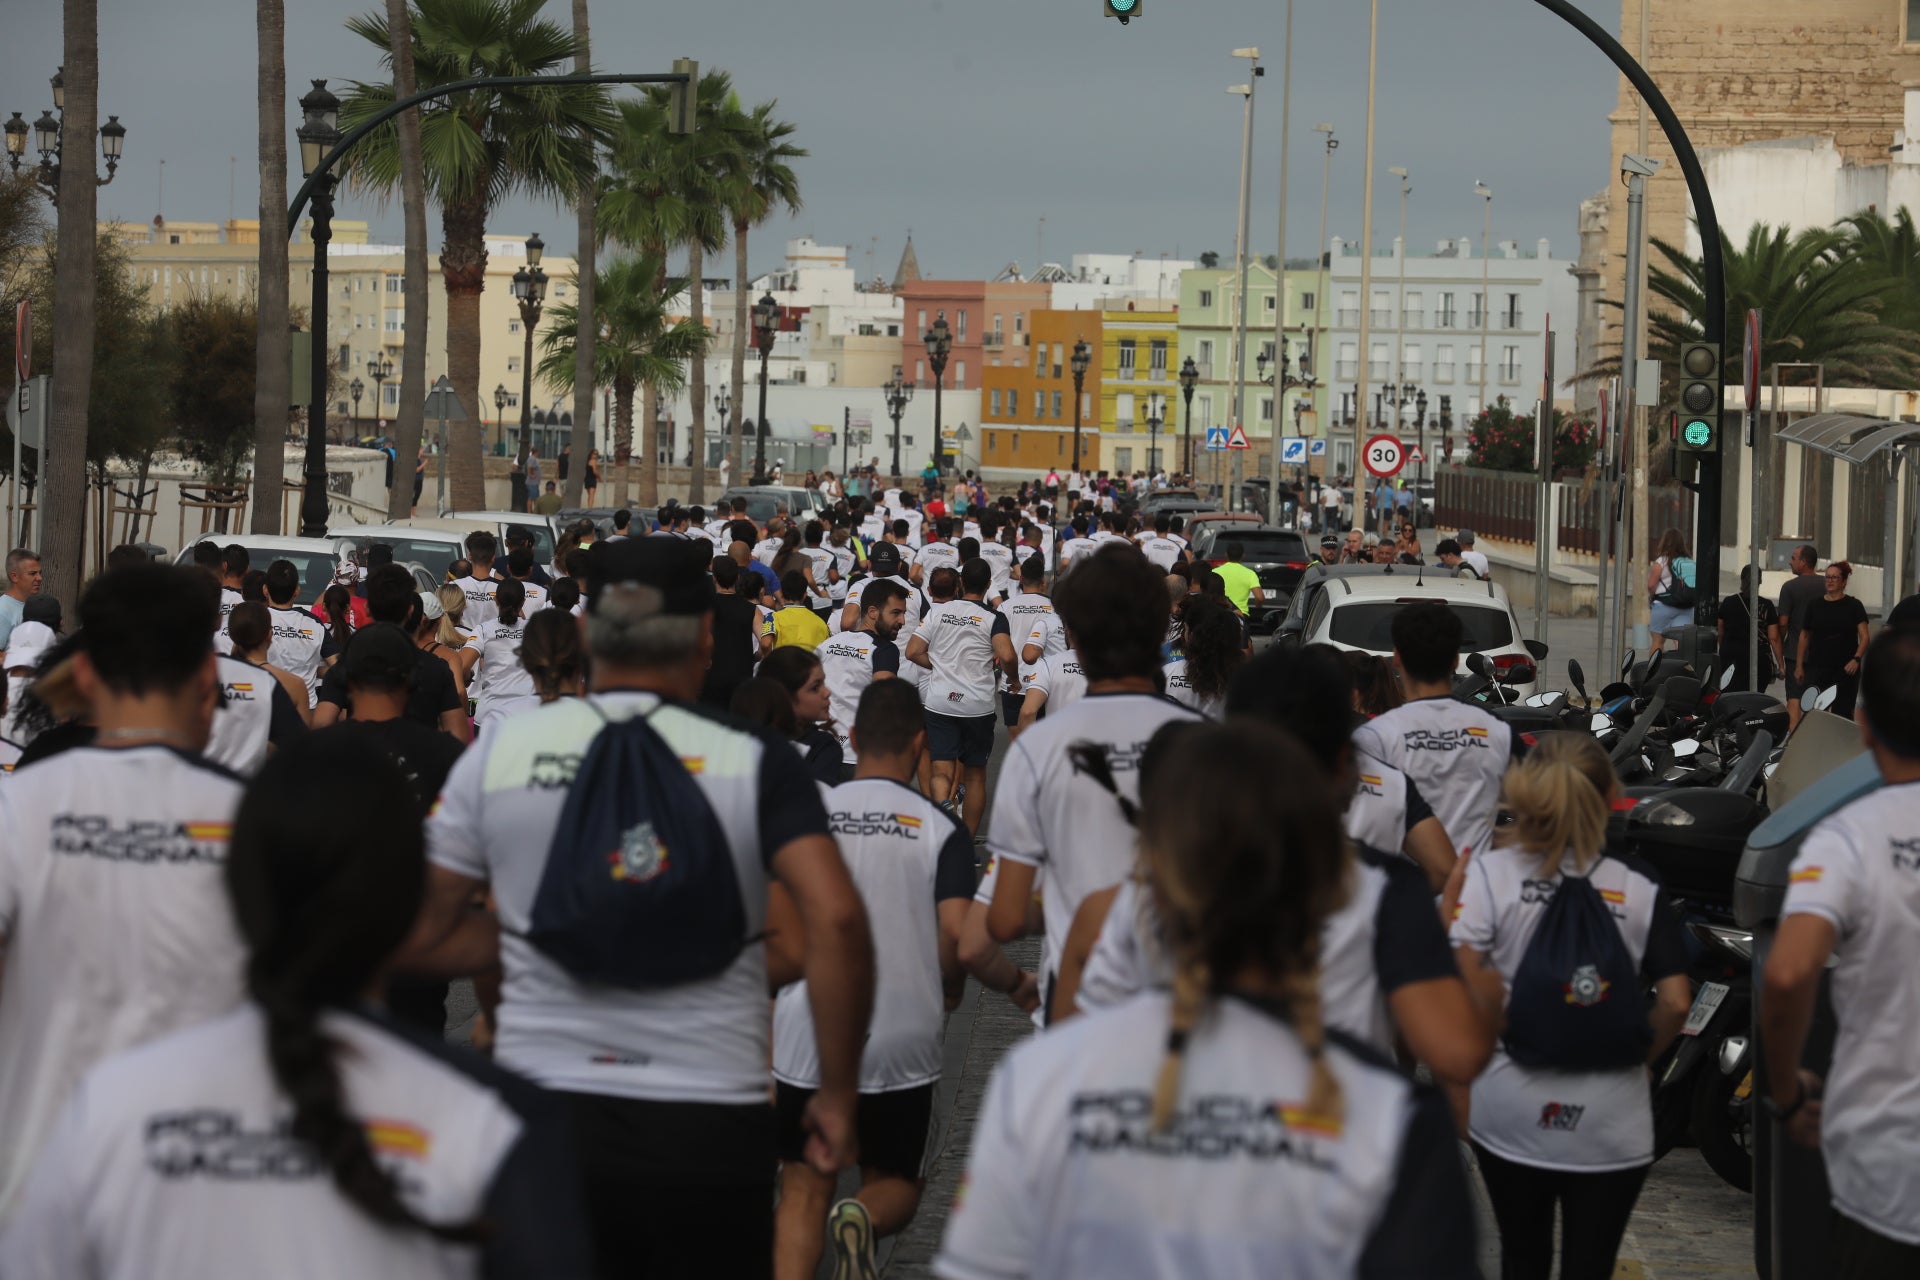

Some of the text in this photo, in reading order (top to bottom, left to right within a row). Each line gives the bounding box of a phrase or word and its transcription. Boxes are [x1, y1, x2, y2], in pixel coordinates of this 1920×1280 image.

[1372, 448, 1396, 463] 30
[271, 631, 314, 640] ACIONAL
[1404, 728, 1471, 741] POLICIA
[1405, 735, 1489, 752] NACIONAL
[829, 811, 899, 824] OLICIA
[829, 823, 919, 840] ACIONAL
